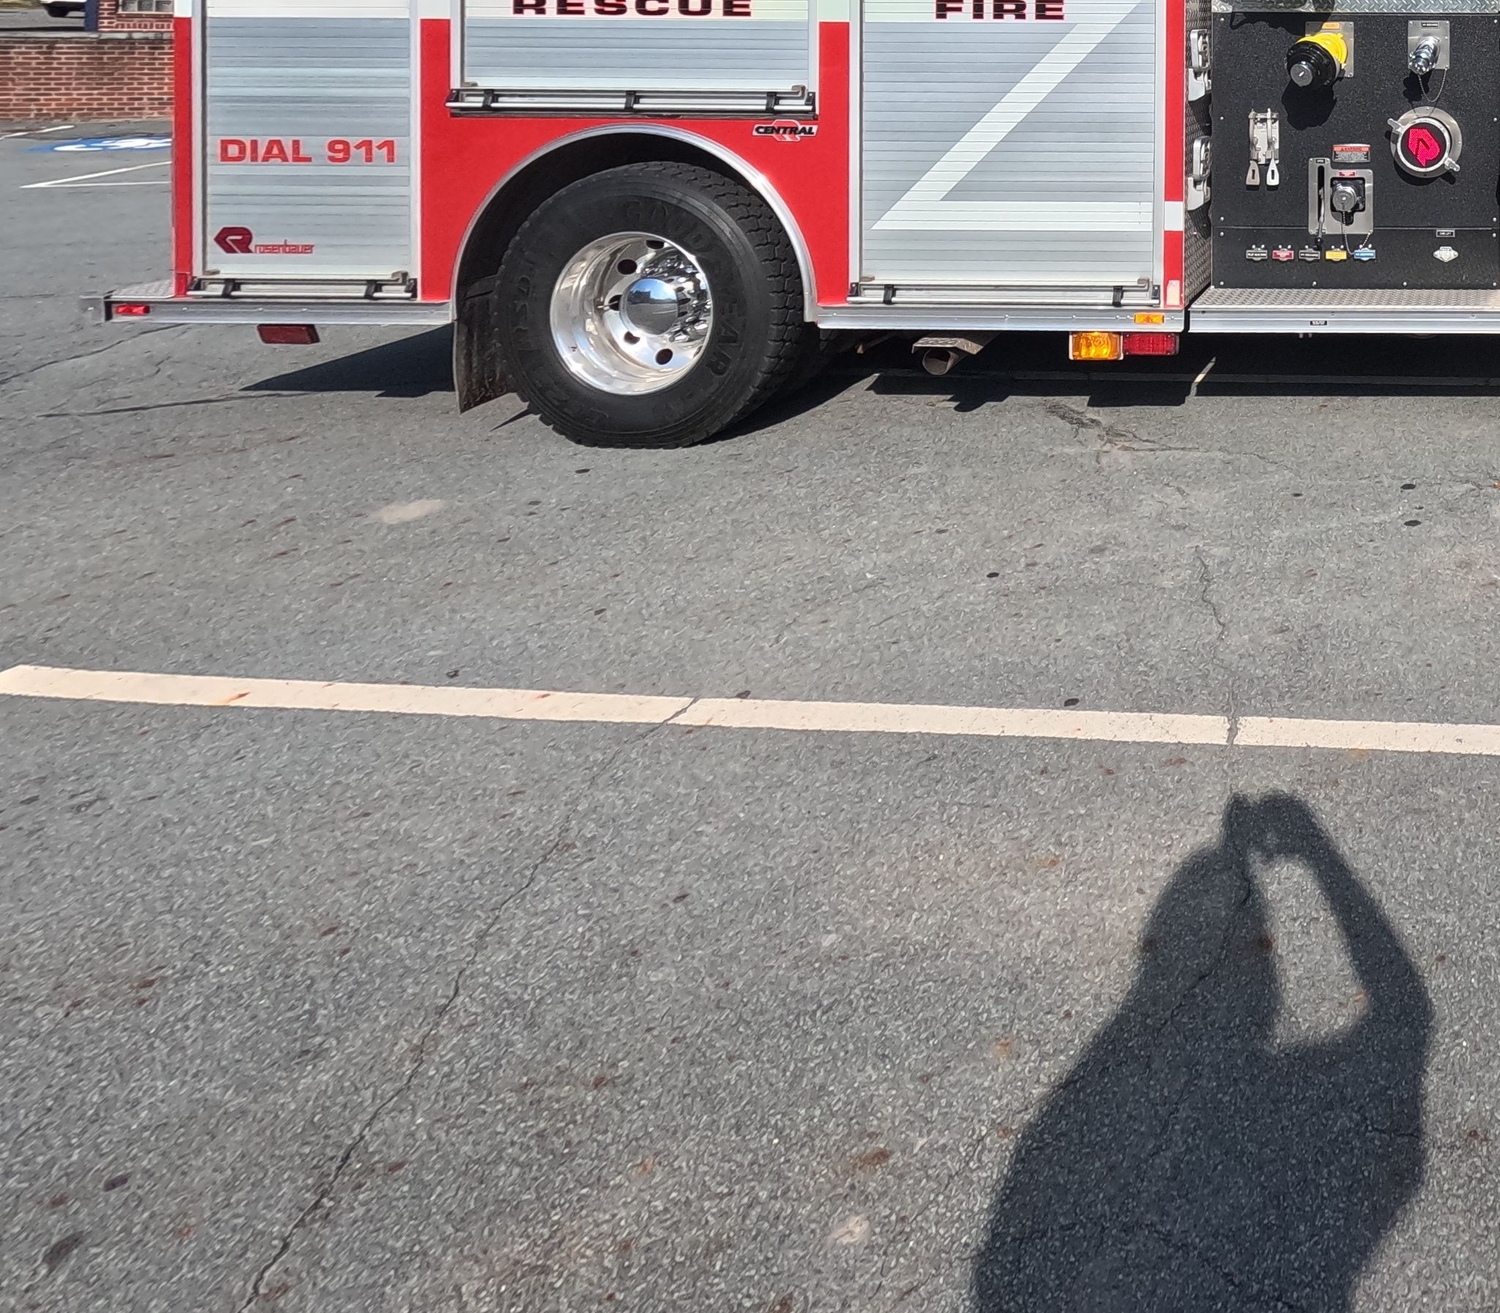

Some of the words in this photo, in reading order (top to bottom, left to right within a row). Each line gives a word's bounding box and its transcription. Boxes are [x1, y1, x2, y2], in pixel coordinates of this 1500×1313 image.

[754, 125, 815, 136] CENTRAL
[219, 139, 313, 163] DIAL
[326, 139, 396, 163] 911
